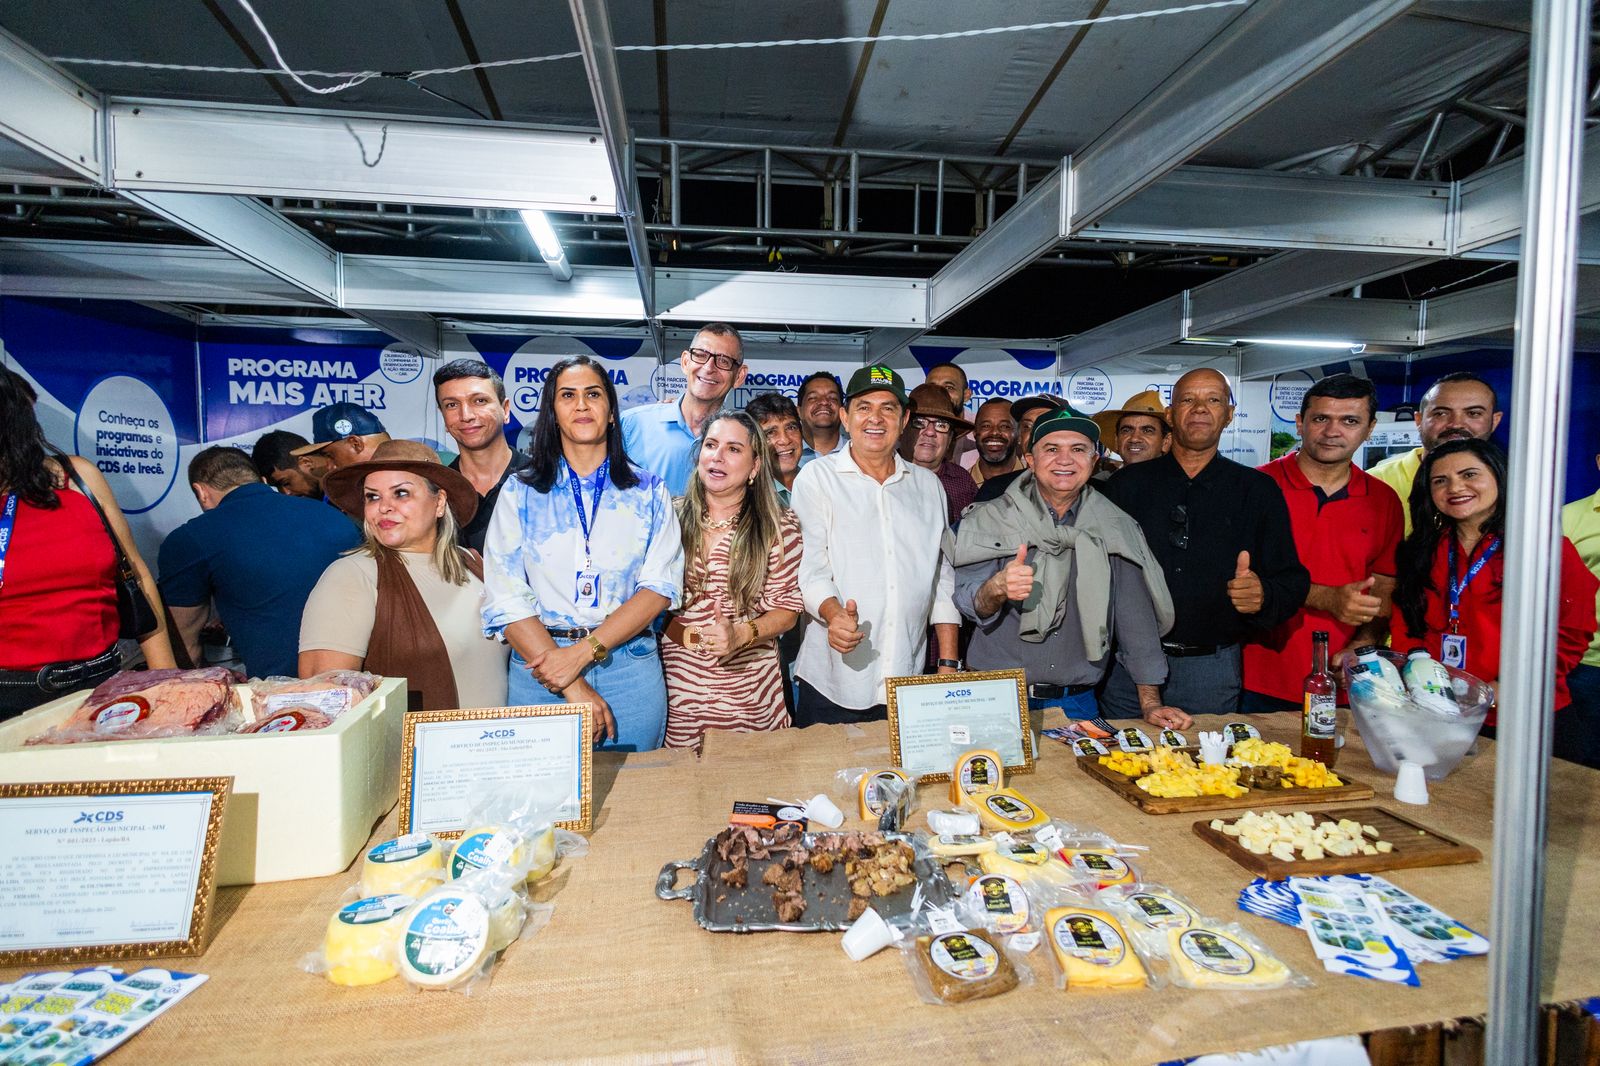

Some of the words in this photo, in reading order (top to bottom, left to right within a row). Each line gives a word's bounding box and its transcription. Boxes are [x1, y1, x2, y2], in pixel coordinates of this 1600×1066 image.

[228, 358, 358, 379] PROGRAMA
[229, 381, 305, 406] MAIS
[311, 383, 386, 409] ATER
[98, 410, 145, 429] Conheça
[148, 419, 159, 429] os
[96, 430, 153, 443] programas
[156, 435, 162, 444] e
[96, 443, 148, 458] iniciativas
[151, 448, 163, 459] do
[97, 460, 120, 473] CDS
[122, 461, 136, 473] de
[138, 462, 164, 474] Irecê.
[495, 729, 516, 737] CDS
[95, 811, 124, 822] CDS
